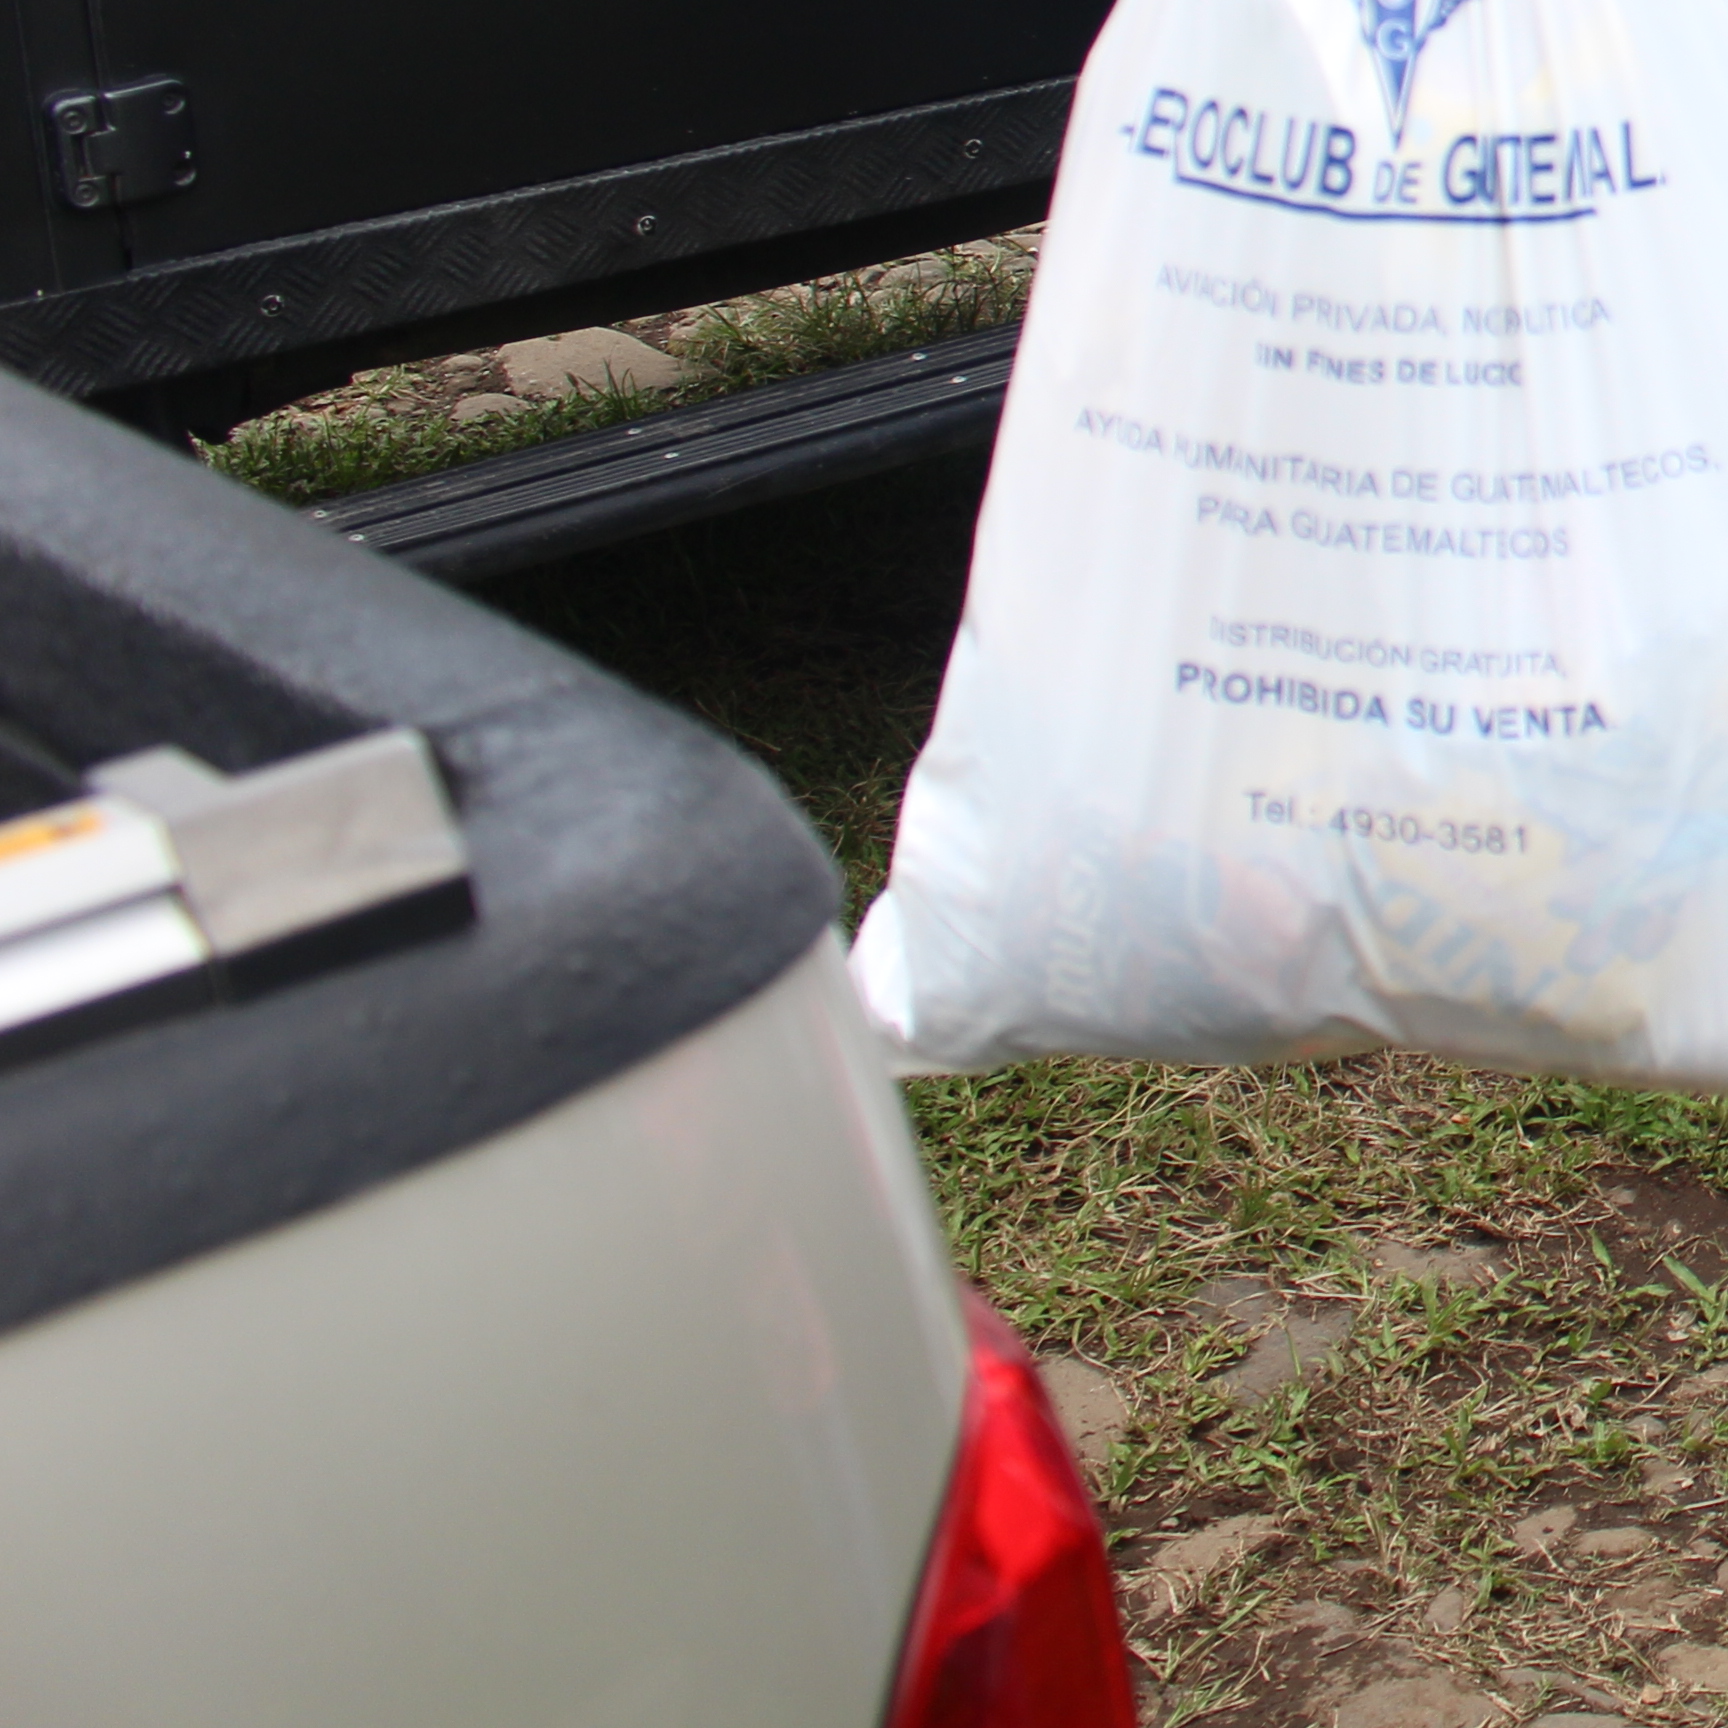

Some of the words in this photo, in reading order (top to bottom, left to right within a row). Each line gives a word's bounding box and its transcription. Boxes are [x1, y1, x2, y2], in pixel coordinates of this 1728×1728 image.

[1373, 161, 1423, 204] DE
[1396, 356, 1437, 385] DE
[1390, 468, 1438, 503] DE
[1175, 660, 1390, 728] PROHIBIDA
[1405, 697, 1456, 737] SU
[1327, 803, 1530, 855] 4930-3581
